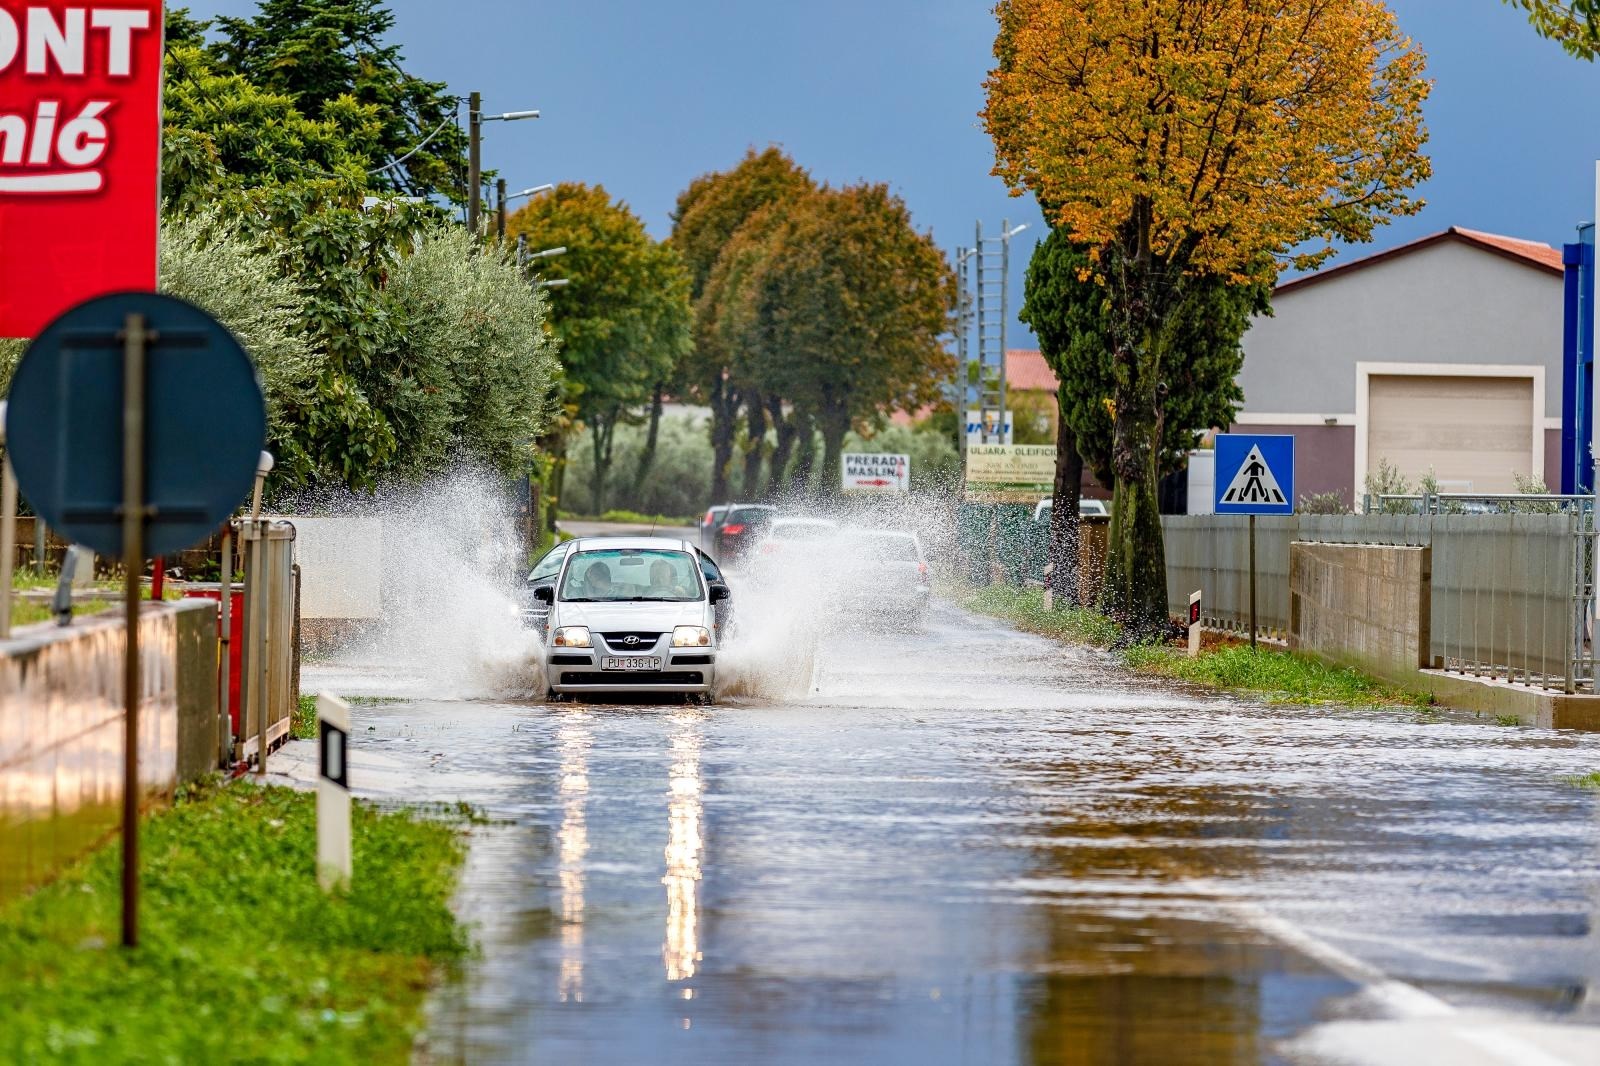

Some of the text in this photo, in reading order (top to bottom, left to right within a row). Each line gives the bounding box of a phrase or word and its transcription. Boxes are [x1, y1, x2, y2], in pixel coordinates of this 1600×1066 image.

[970, 447, 1006, 455] ULJARA
[846, 456, 905, 466] PRERADA
[847, 467, 903, 477] MASLIN
